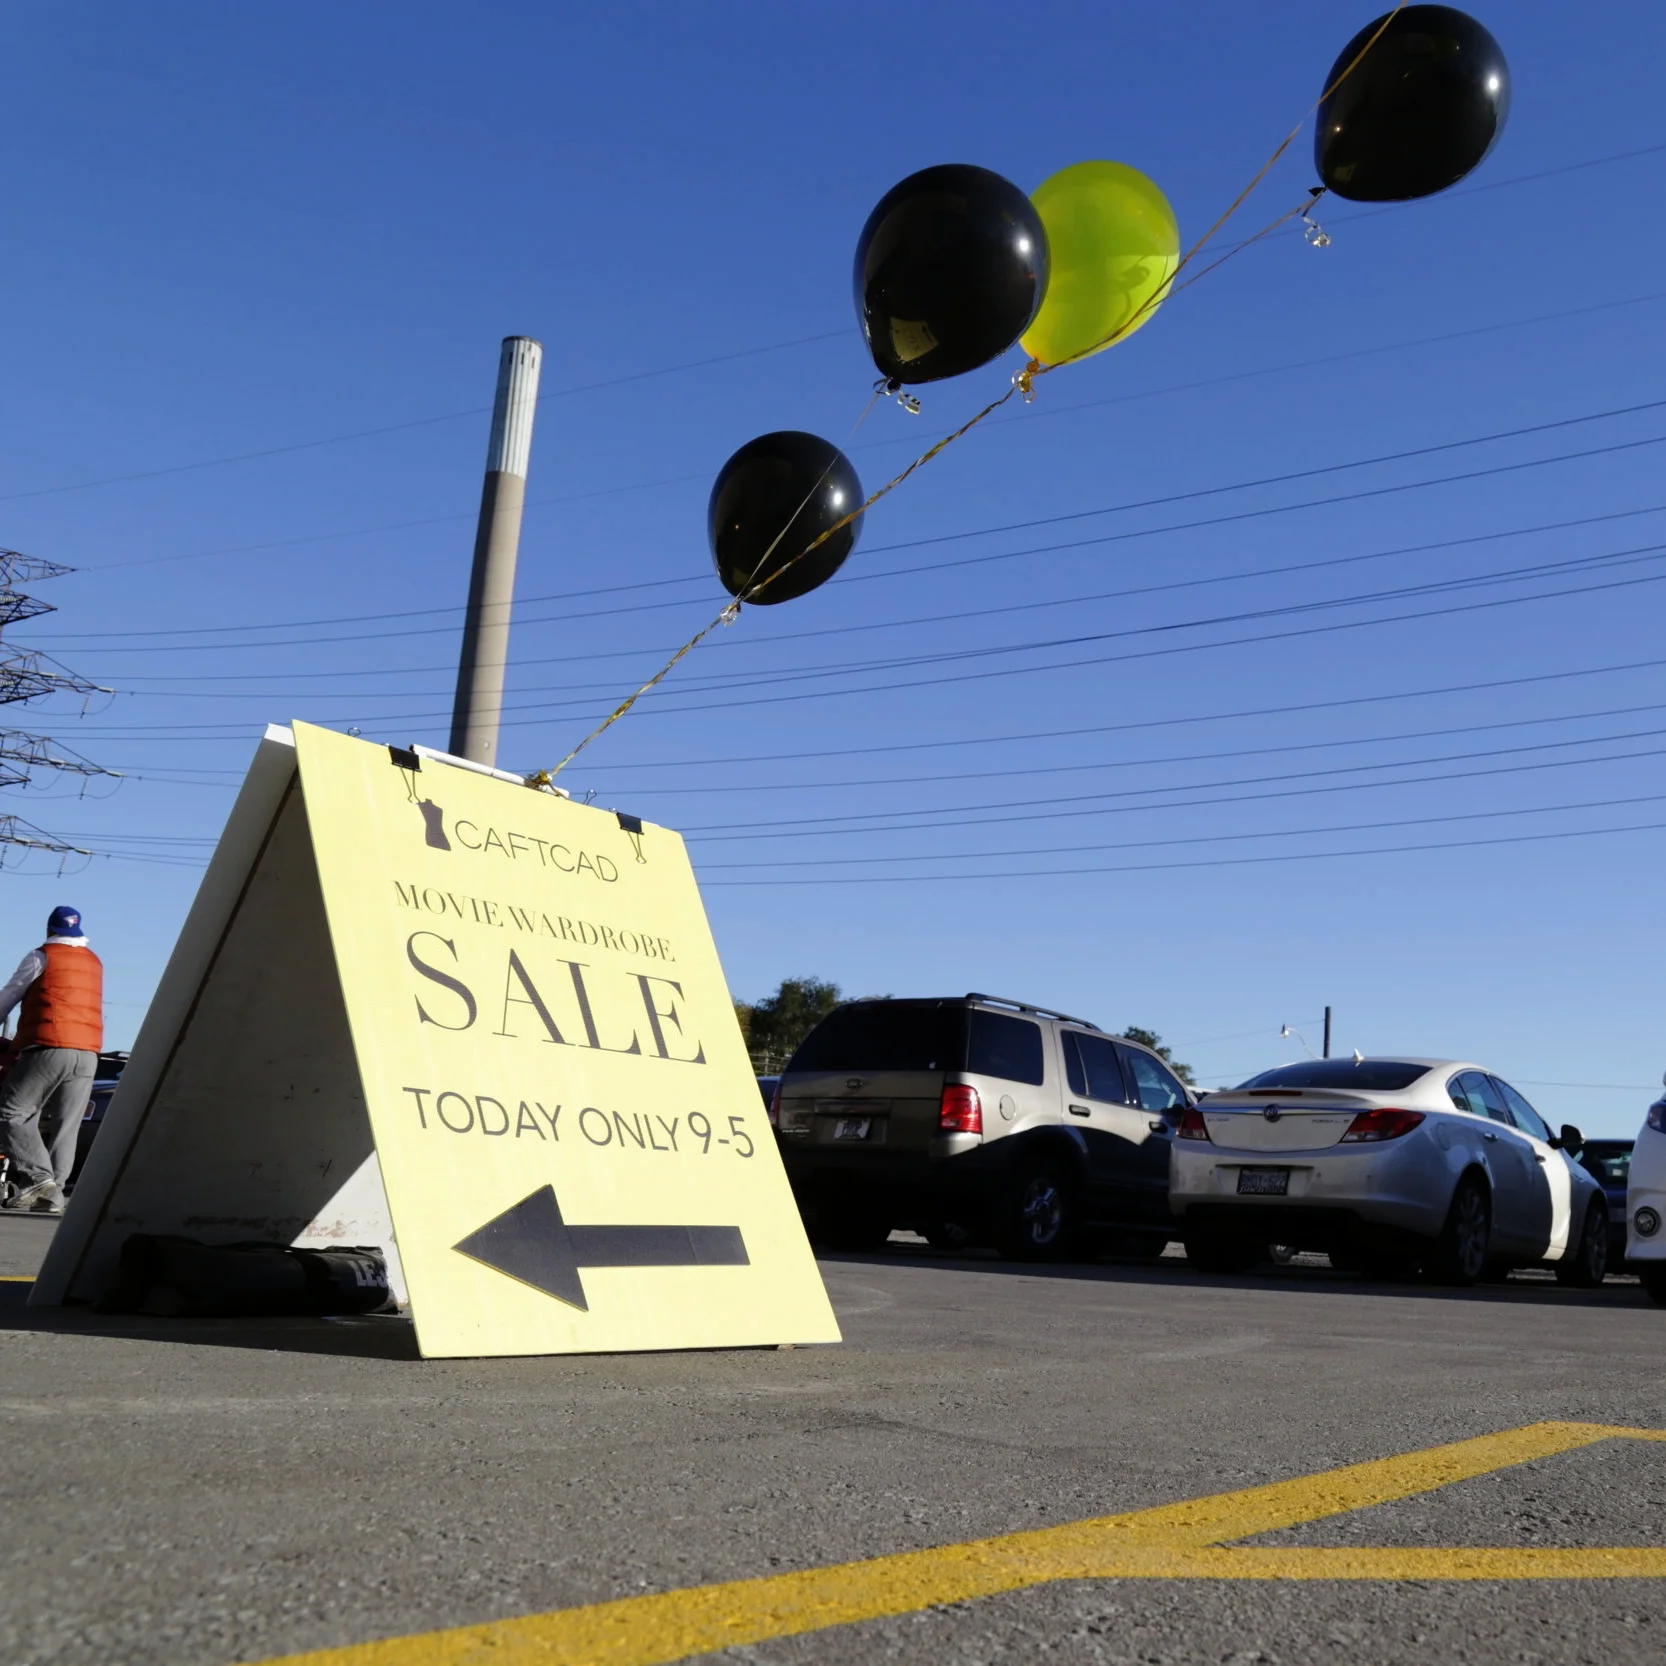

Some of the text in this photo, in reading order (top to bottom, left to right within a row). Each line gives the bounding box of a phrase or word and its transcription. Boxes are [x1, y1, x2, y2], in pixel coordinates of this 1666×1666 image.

[455, 820, 618, 882] CAFTCAD
[393, 880, 676, 962] MOVIE WARDROBE
[406, 931, 706, 1064] SALE
[402, 1086, 754, 1158] TODAY ONLY 9-5
